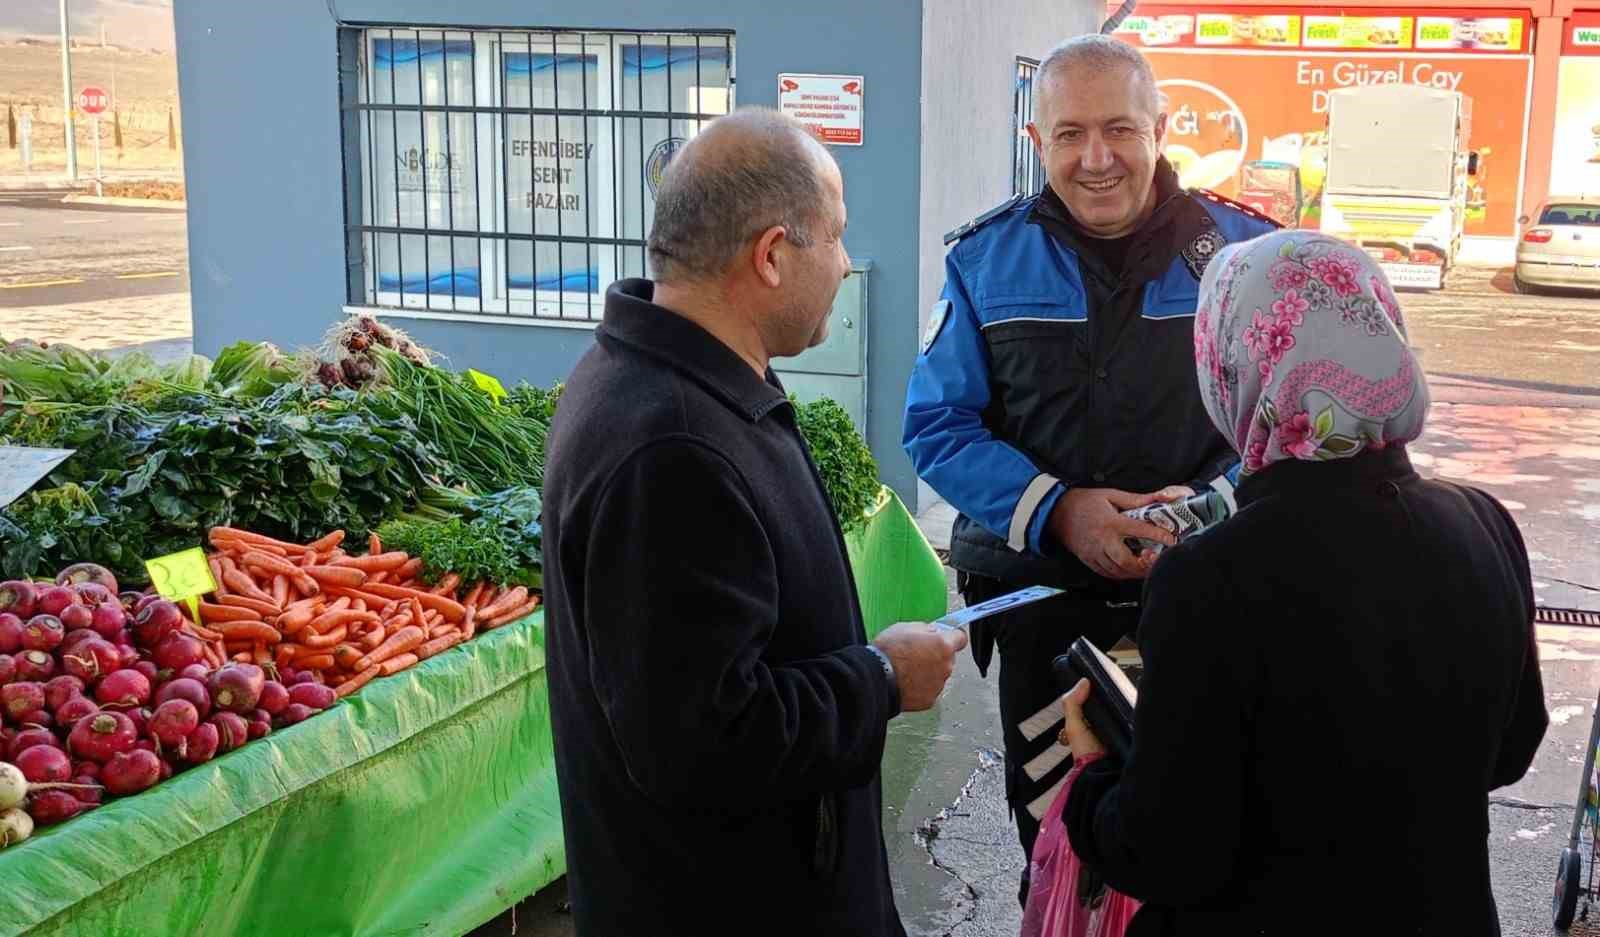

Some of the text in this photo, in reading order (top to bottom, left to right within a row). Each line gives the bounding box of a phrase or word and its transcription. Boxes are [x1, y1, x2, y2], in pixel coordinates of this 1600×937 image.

[1296, 61, 1324, 85] En
[1333, 60, 1404, 86] Güzel
[512, 139, 594, 159] EFENDİBEY
[526, 192, 579, 211] PAZARI
